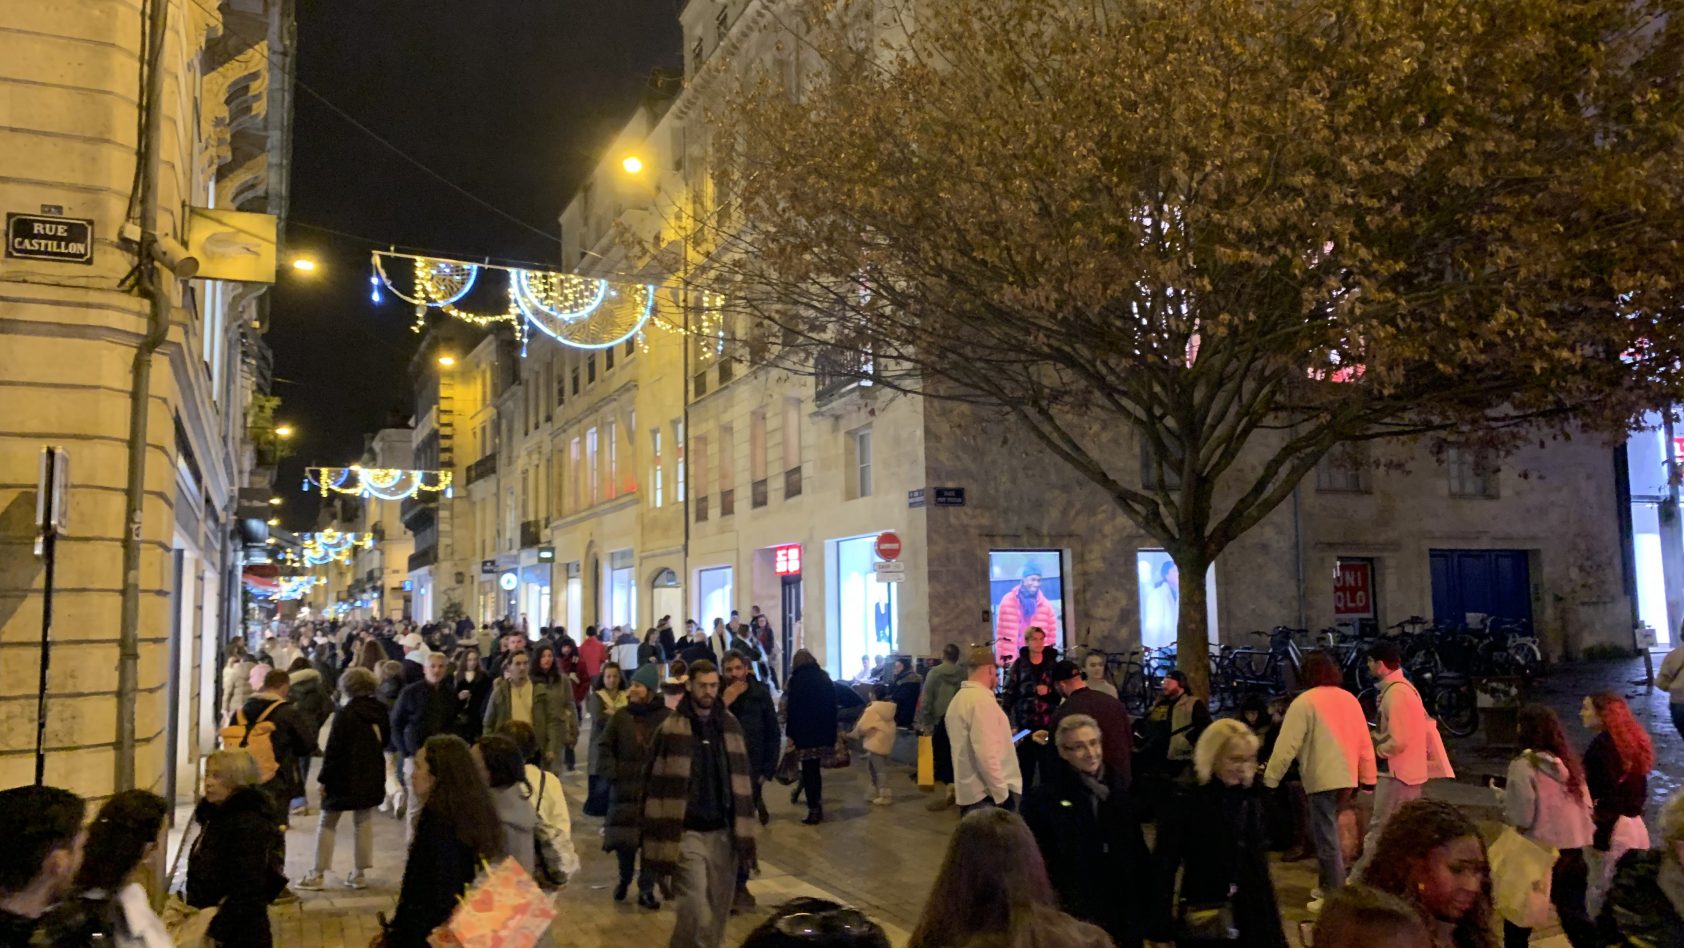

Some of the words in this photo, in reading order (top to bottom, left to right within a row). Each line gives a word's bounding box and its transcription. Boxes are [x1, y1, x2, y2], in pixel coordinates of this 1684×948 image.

[33, 223, 68, 236] RUE
[14, 238, 85, 254] CASTILLON
[1334, 570, 1362, 587] UNI
[1335, 590, 1366, 608] QLO
